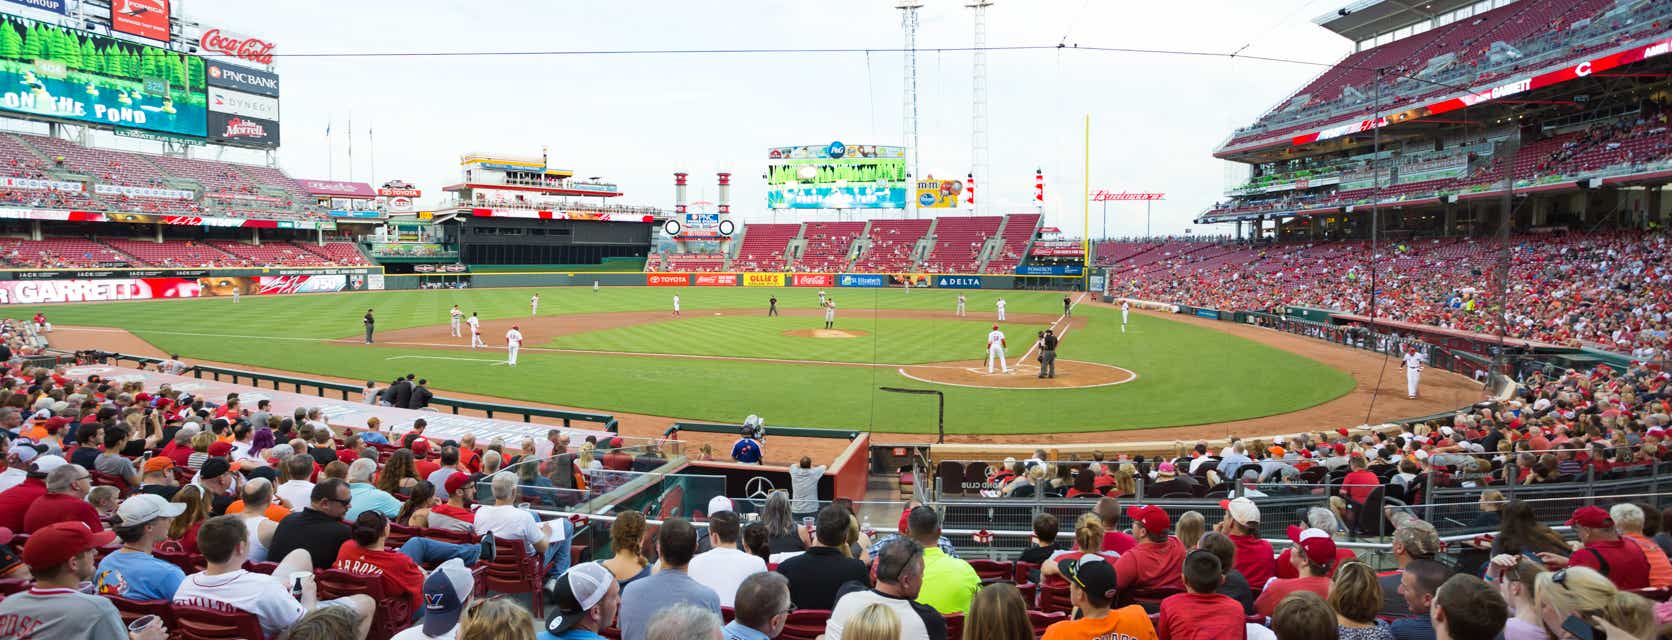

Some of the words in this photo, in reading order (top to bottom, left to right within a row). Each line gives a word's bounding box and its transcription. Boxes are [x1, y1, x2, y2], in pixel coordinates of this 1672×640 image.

[201, 28, 276, 65] Coca-Cola
[223, 69, 247, 84] PNC
[248, 75, 277, 89] BANK
[4, 92, 35, 109] ON
[94, 103, 146, 123] POND
[229, 97, 273, 112] DYNEGY
[15, 280, 136, 303] GARRETT
[949, 278, 980, 286] DELTA
